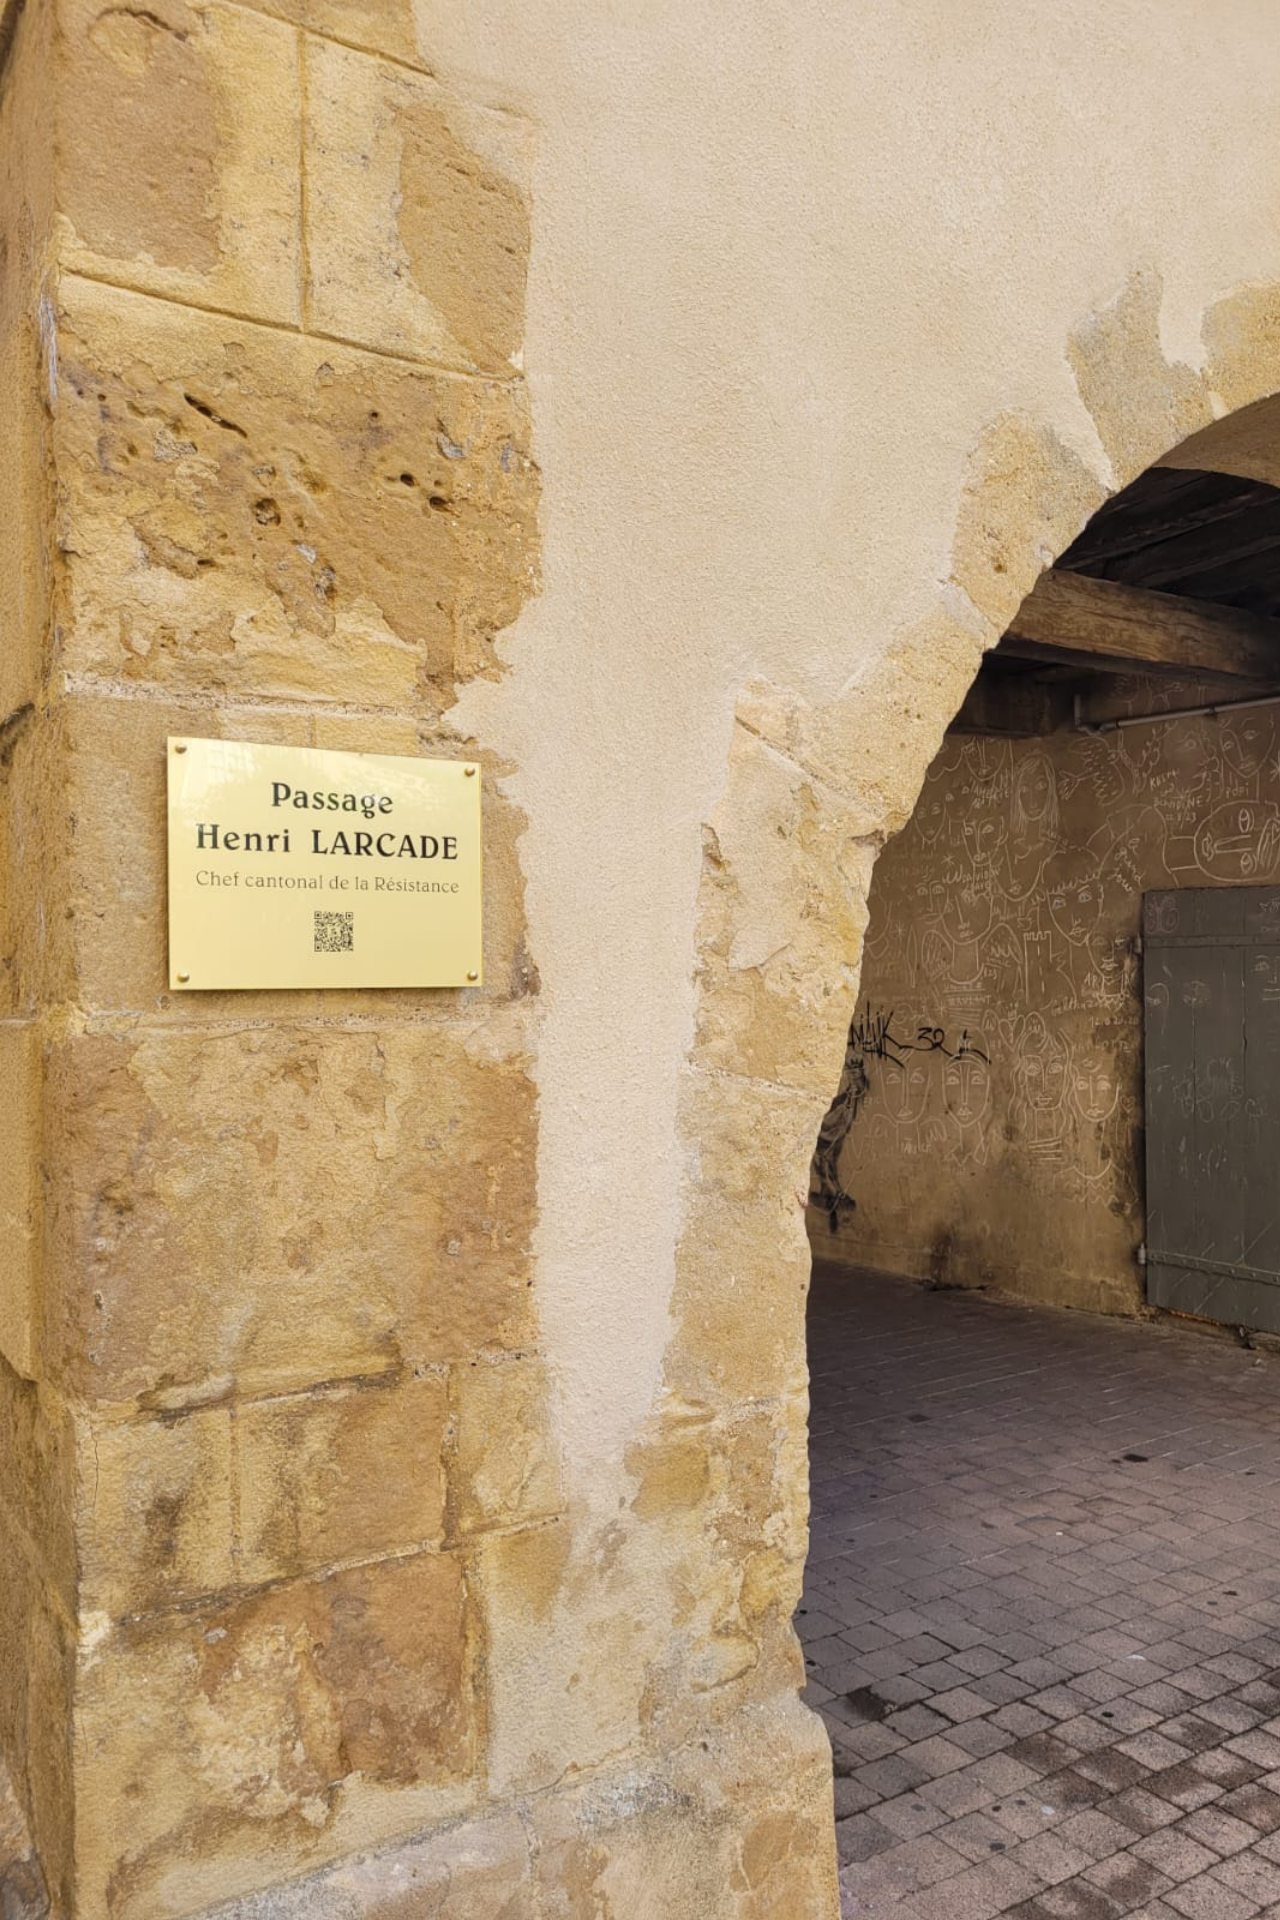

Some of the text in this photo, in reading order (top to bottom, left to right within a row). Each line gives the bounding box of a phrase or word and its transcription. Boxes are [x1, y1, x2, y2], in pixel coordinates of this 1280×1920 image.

[271, 781, 394, 820] Passage
[195, 822, 459, 860] Henri LARCADE
[195, 869, 460, 894] Chef cantonal de la Résistance
